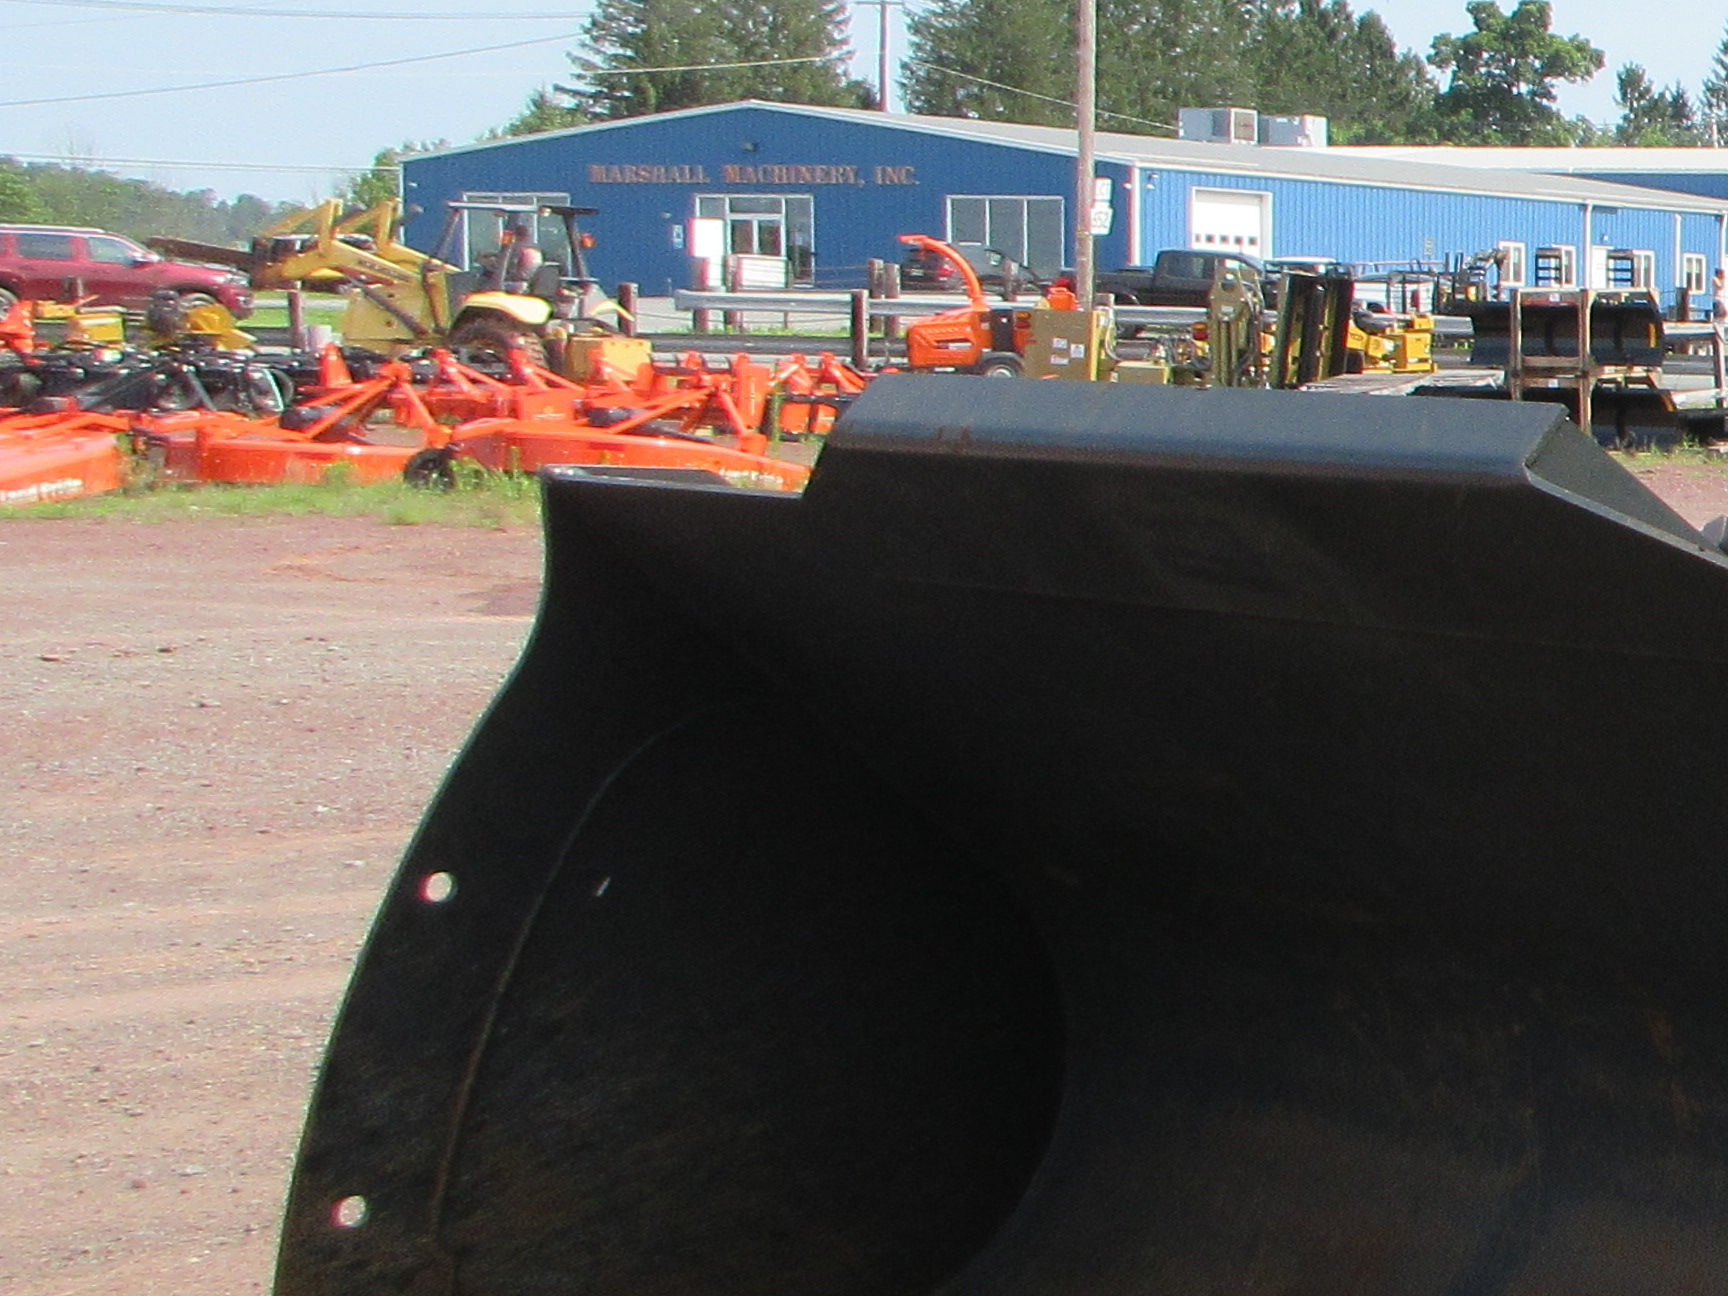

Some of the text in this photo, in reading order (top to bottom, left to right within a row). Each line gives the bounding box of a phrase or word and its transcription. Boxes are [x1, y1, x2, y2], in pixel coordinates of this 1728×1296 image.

[588, 164, 920, 188] MARSHALL MACHINERY, INC.
